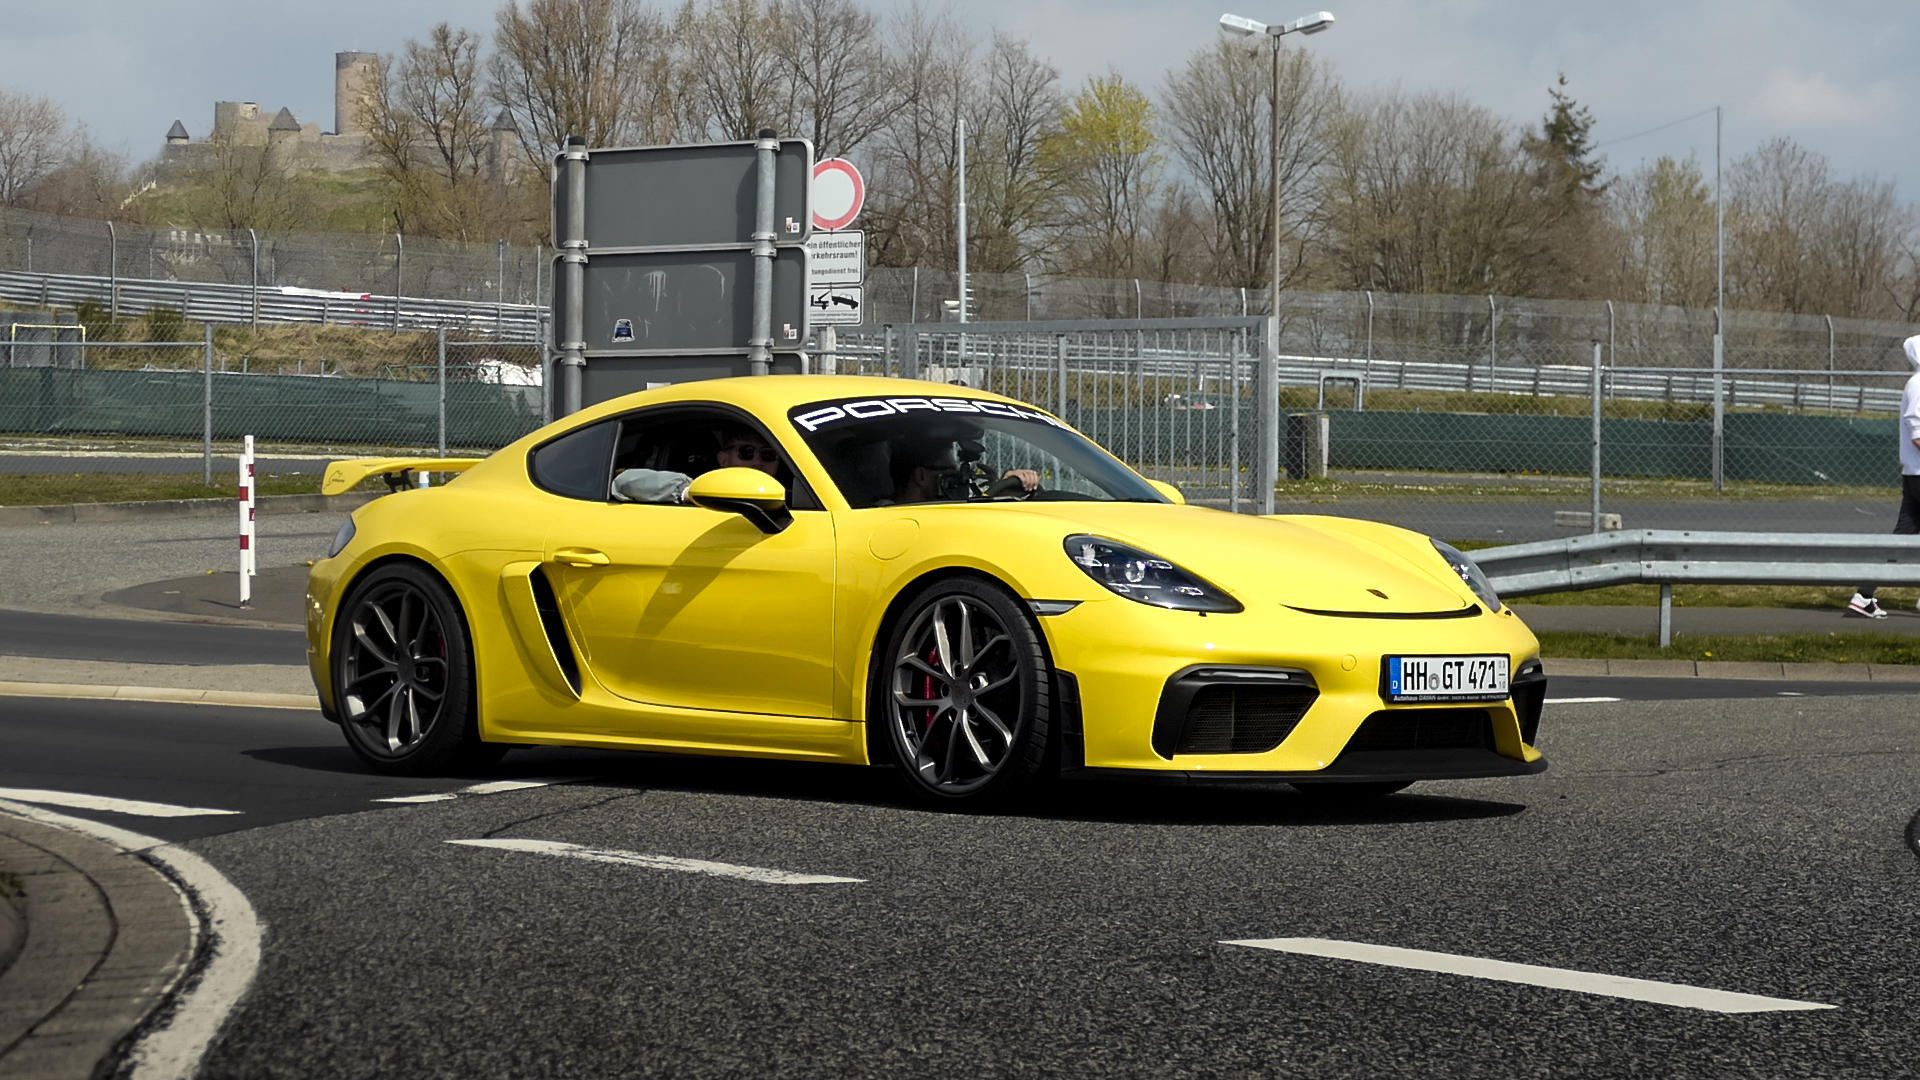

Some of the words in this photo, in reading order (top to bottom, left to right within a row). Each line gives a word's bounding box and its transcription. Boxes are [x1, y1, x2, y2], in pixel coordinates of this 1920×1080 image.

[806, 241, 818, 249] ein
[818, 240, 861, 249] öffentlicher
[810, 250, 858, 260] rkehrsraum!
[811, 268, 847, 276] tungsdienst
[794, 398, 1078, 434] PORSCH
[1403, 661, 1427, 690] HH
[1442, 661, 1464, 690] GT
[1468, 660, 1497, 689] 471
[1392, 680, 1398, 689] D
